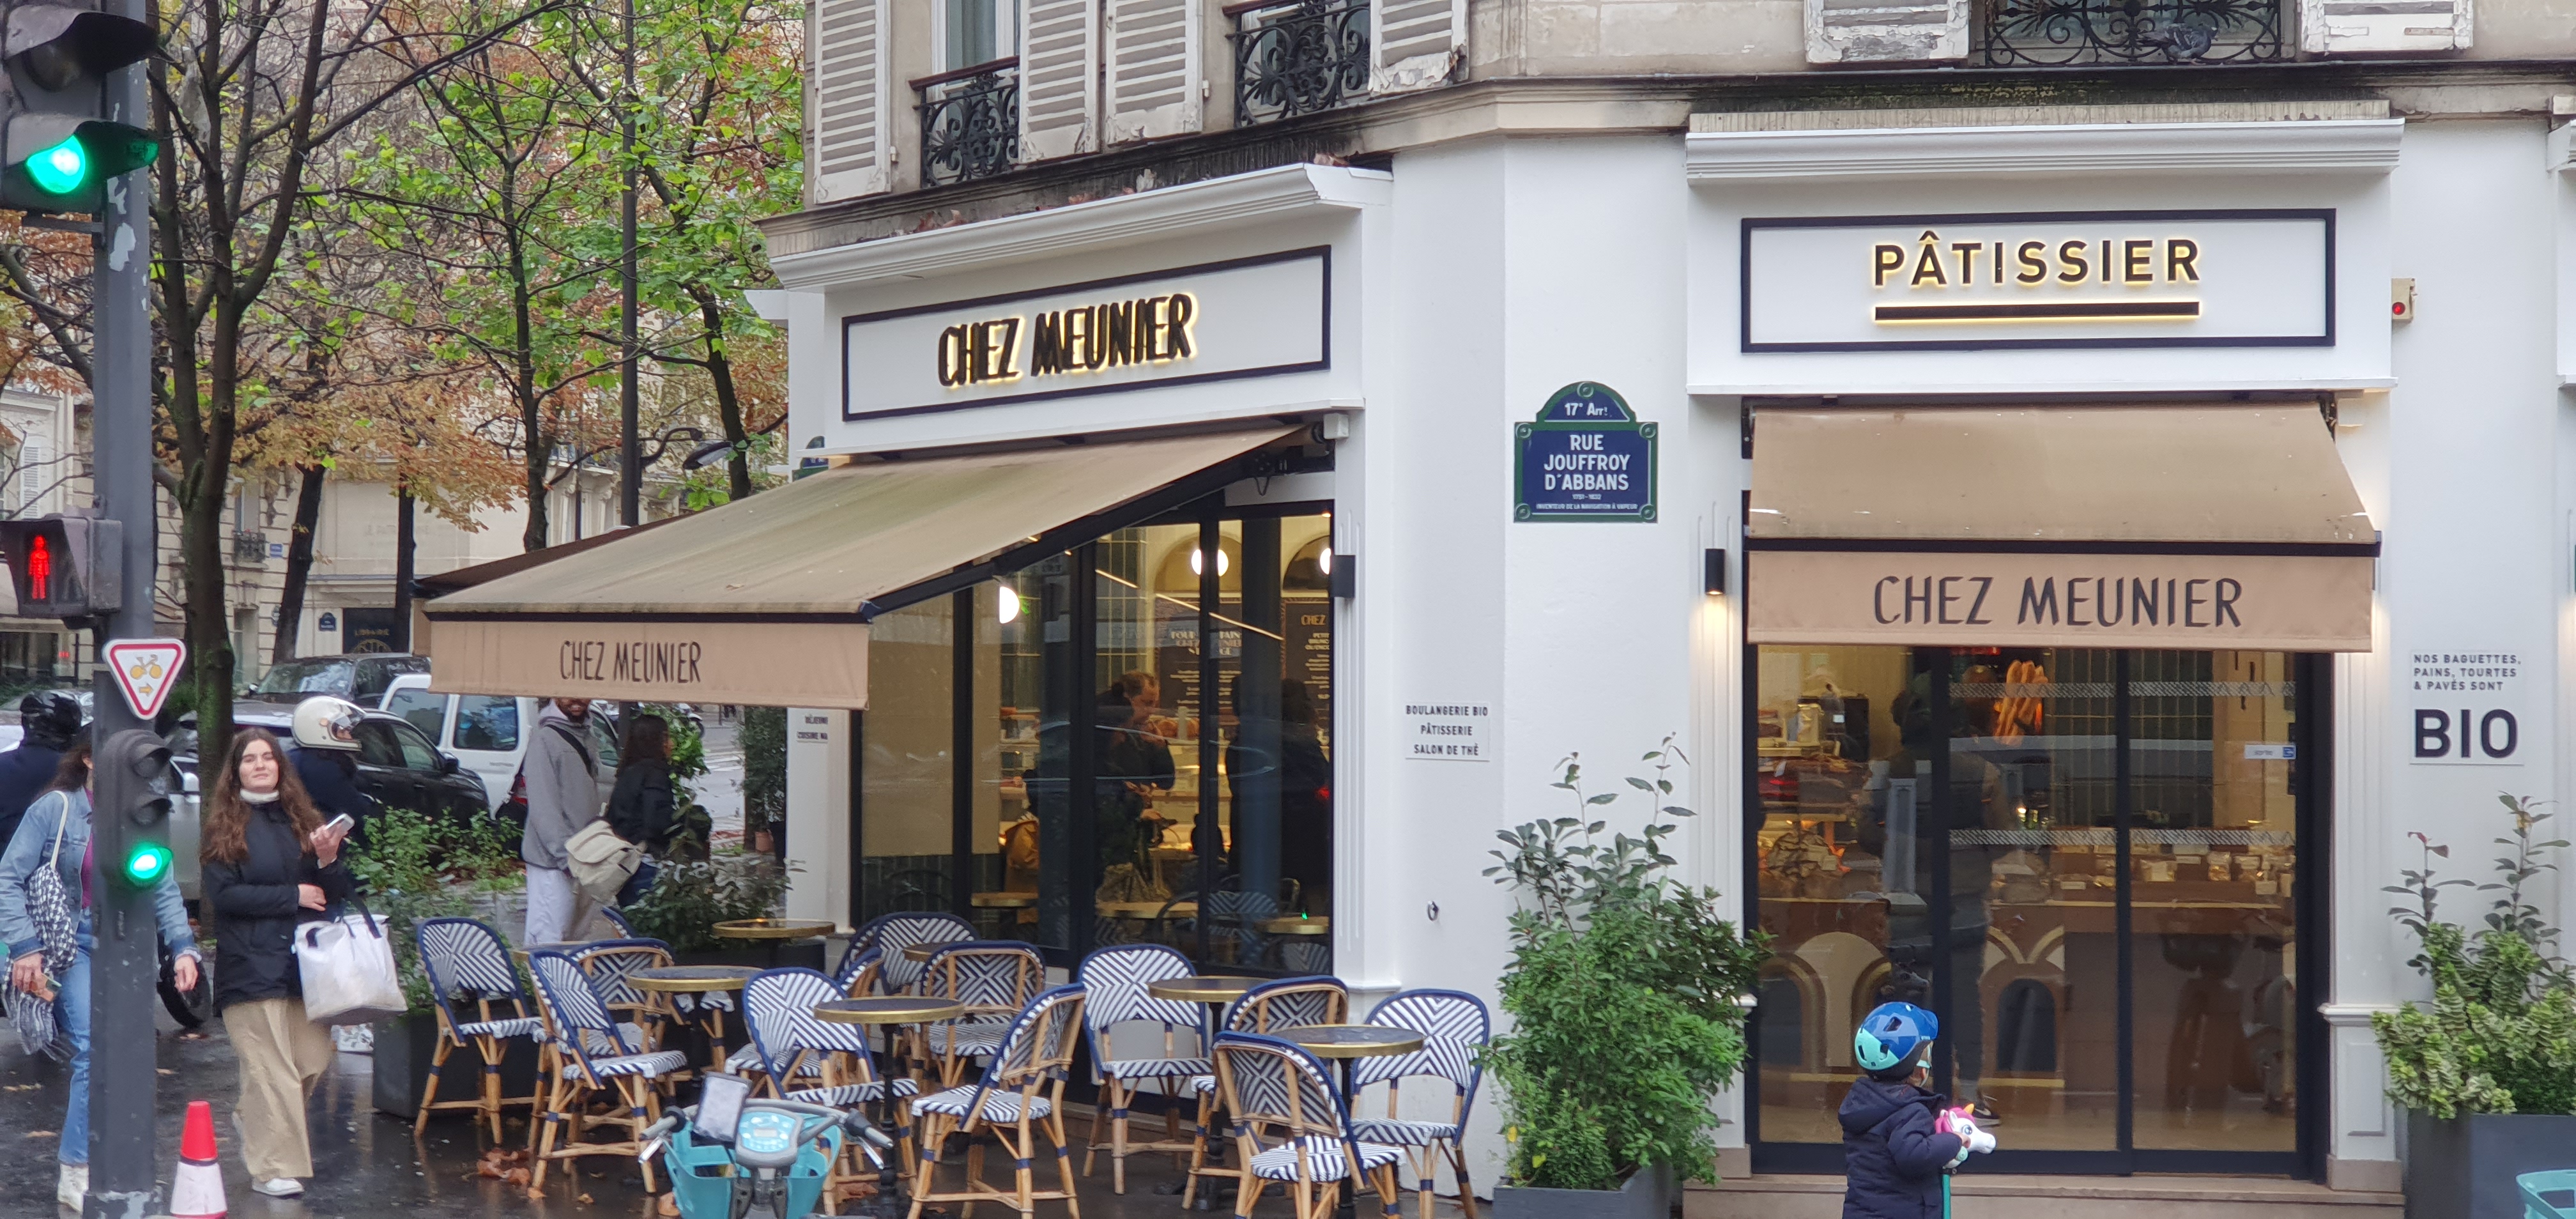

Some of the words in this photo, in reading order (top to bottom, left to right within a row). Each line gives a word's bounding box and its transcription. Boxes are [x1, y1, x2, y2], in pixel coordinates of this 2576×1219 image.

[1874, 230, 2200, 286] PÂTISSIER
[937, 318, 1022, 387] CHEZ
[1031, 293, 1193, 377] MEUNIER
[1570, 434, 1604, 451] RUE
[1544, 454, 1631, 471] JOUFFROY
[1545, 474, 1629, 491] D'ABBANS
[1874, 576, 1994, 625] CHEZ
[2017, 576, 2243, 628] MEUNIER
[560, 640, 605, 681] CHEZ
[613, 641, 702, 683] MEUNIER
[2414, 654, 2439, 664] NOS
[2443, 654, 2521, 664] BAGUETTES,
[2414, 668, 2455, 678] PAINS,
[2460, 668, 2517, 677] TOURTES
[2414, 681, 2422, 691] &
[2426, 678, 2466, 691] PAVÉS
[2470, 681, 2504, 691] SONT
[1406, 705, 1469, 716] BOULANGERIE
[1473, 706, 1488, 716] BIO
[1420, 722, 1473, 736] PÂTISSERIE
[2414, 709, 2518, 758] BIO
[1414, 744, 1443, 755] SALON
[1446, 745, 1458, 755] DE
